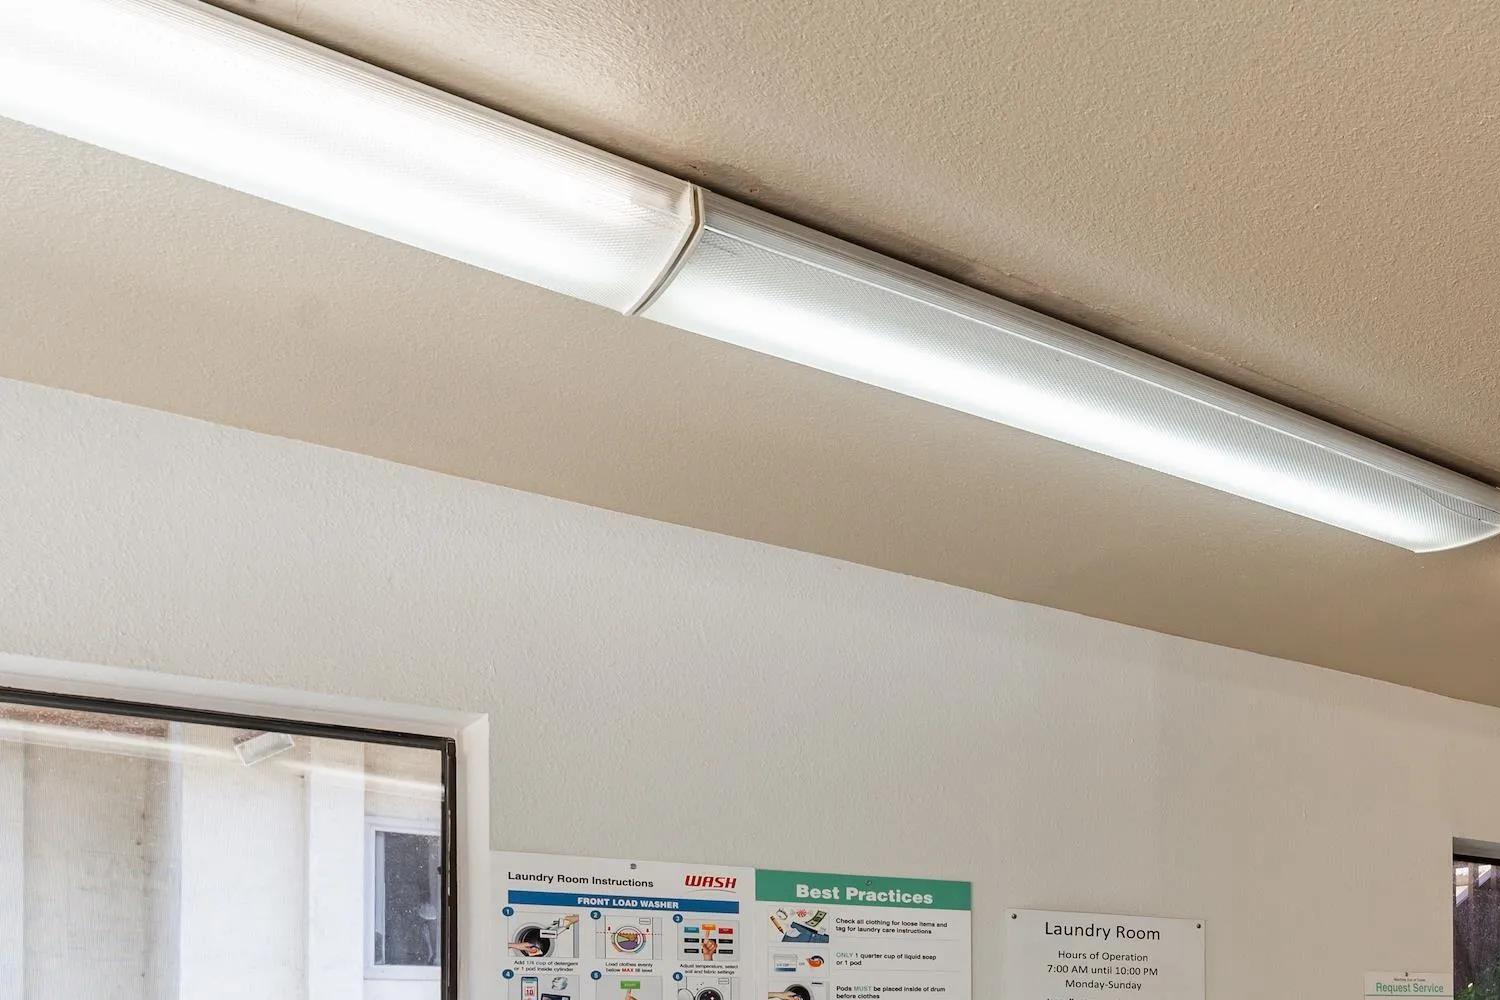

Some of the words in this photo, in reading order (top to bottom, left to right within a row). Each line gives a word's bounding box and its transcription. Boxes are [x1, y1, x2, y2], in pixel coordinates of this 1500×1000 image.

[508, 872, 554, 883] Laundry
[557, 874, 588, 883] Room
[592, 877, 653, 887] Instructions
[684, 875, 737, 889] WASH
[796, 884, 839, 899] Best
[846, 887, 933, 903] Practices
[577, 897, 610, 905] FRONT
[612, 899, 638, 907] LOAD
[639, 900, 679, 908] WASHER
[1045, 922, 1110, 940] Laundry
[1116, 925, 1160, 939] Room
[1058, 950, 1087, 959] Hours
[1089, 951, 1099, 959] of
[1101, 952, 1148, 961] Operation
[1047, 964, 1068, 973] 7:00
[1071, 965, 1088, 973] AM
[1091, 966, 1112, 974] until
[1115, 966, 1141, 975] 10:00
[1143, 967, 1158, 975] PM
[1065, 980, 1141, 990] Monday-Sunday
[1376, 982, 1411, 993] Request
[1413, 983, 1444, 993] Service
